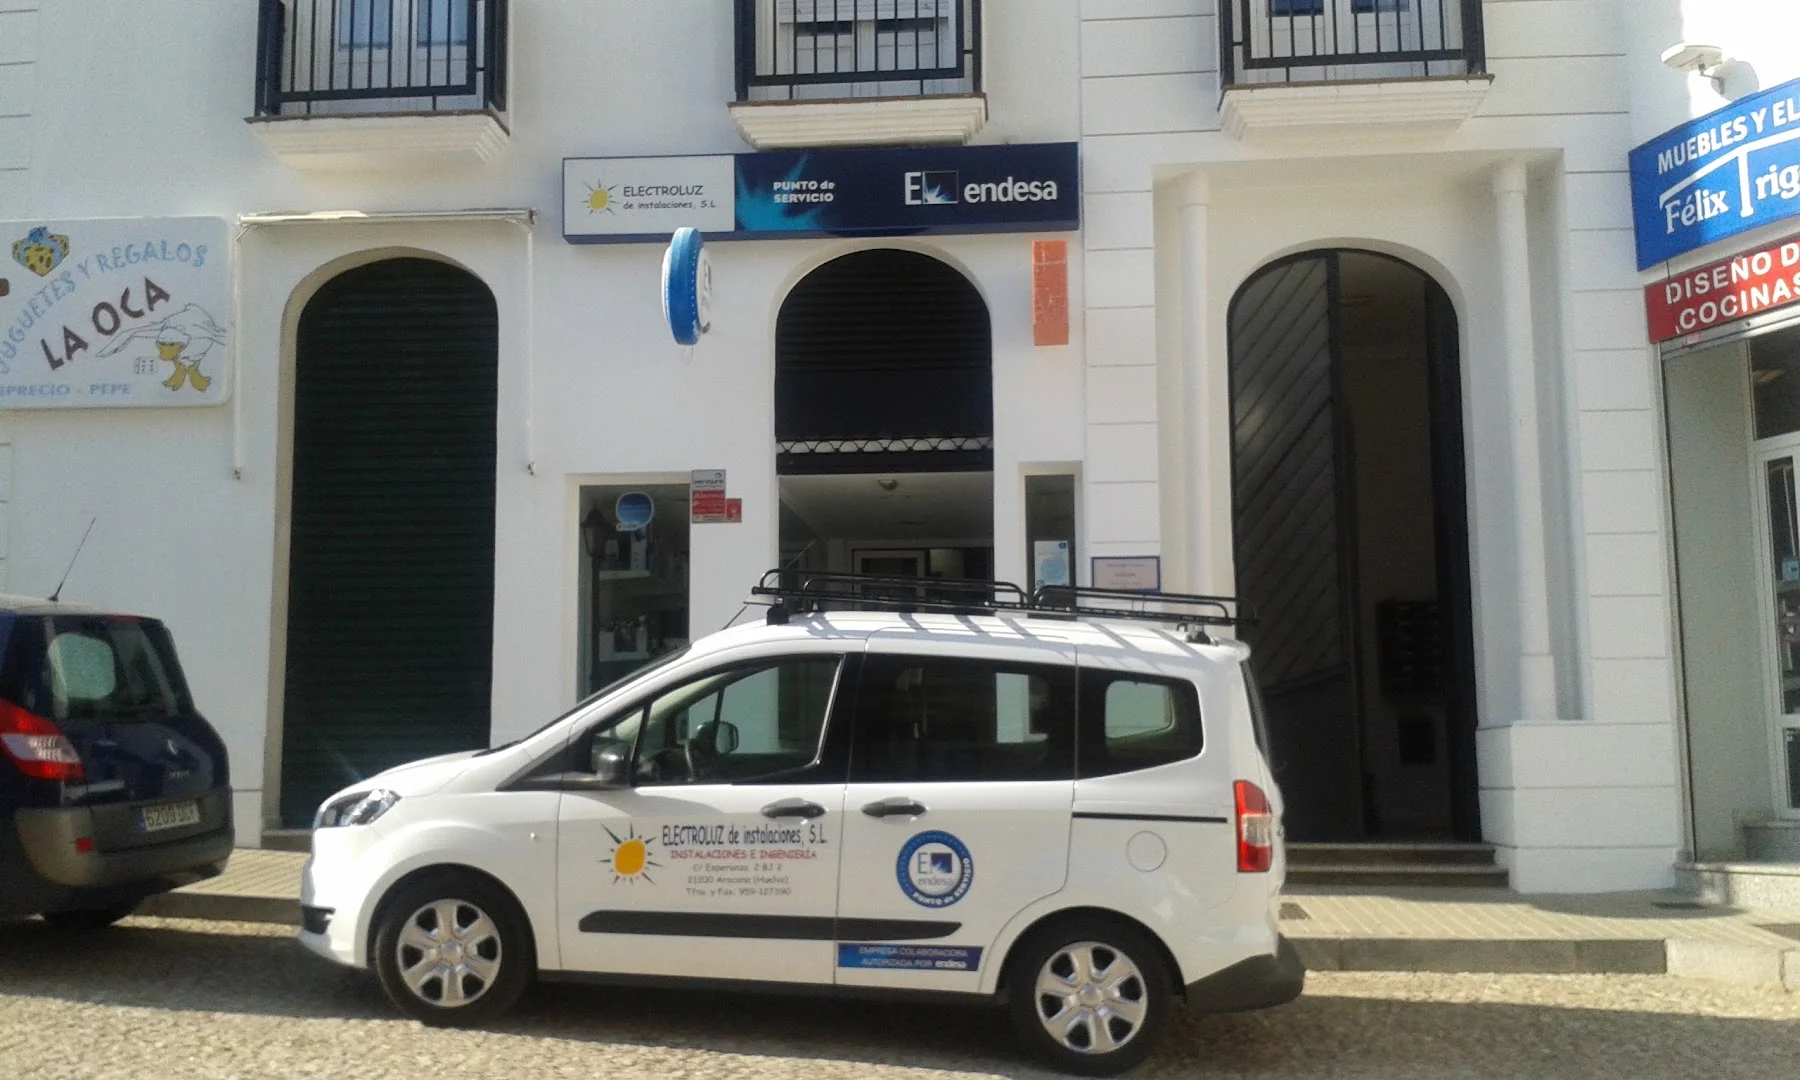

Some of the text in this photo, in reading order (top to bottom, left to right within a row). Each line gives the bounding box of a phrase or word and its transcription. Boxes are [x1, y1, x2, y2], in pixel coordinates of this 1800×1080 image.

[1657, 115, 1748, 175] MUEBLES
[1750, 107, 1767, 134] Y
[623, 185, 704, 197] ELECTROLUZ
[773, 179, 835, 191] PUNTO de
[964, 176, 1058, 204] endesa
[774, 192, 834, 203] SERVICIO
[623, 201, 634, 210] de
[1665, 188, 1730, 235] Félix
[77, 256, 91, 280] Y
[96, 239, 208, 274] REGALOS
[1666, 251, 1772, 305] DISEÑO
[41, 276, 170, 371] LA OCA
[90, 383, 131, 396] PEPE
[662, 825, 725, 846] ELECTROLUZ
[728, 824, 739, 845] de
[671, 850, 747, 860] INSTALACIONES
[751, 850, 757, 860] E
[717, 875, 751, 884] Aracena
[912, 891, 942, 906] PUNTO
[859, 945, 968, 958] EMPRESA COLABORADORA
[861, 957, 913, 967] AUTORIZADA
[934, 958, 967, 969] endesa
